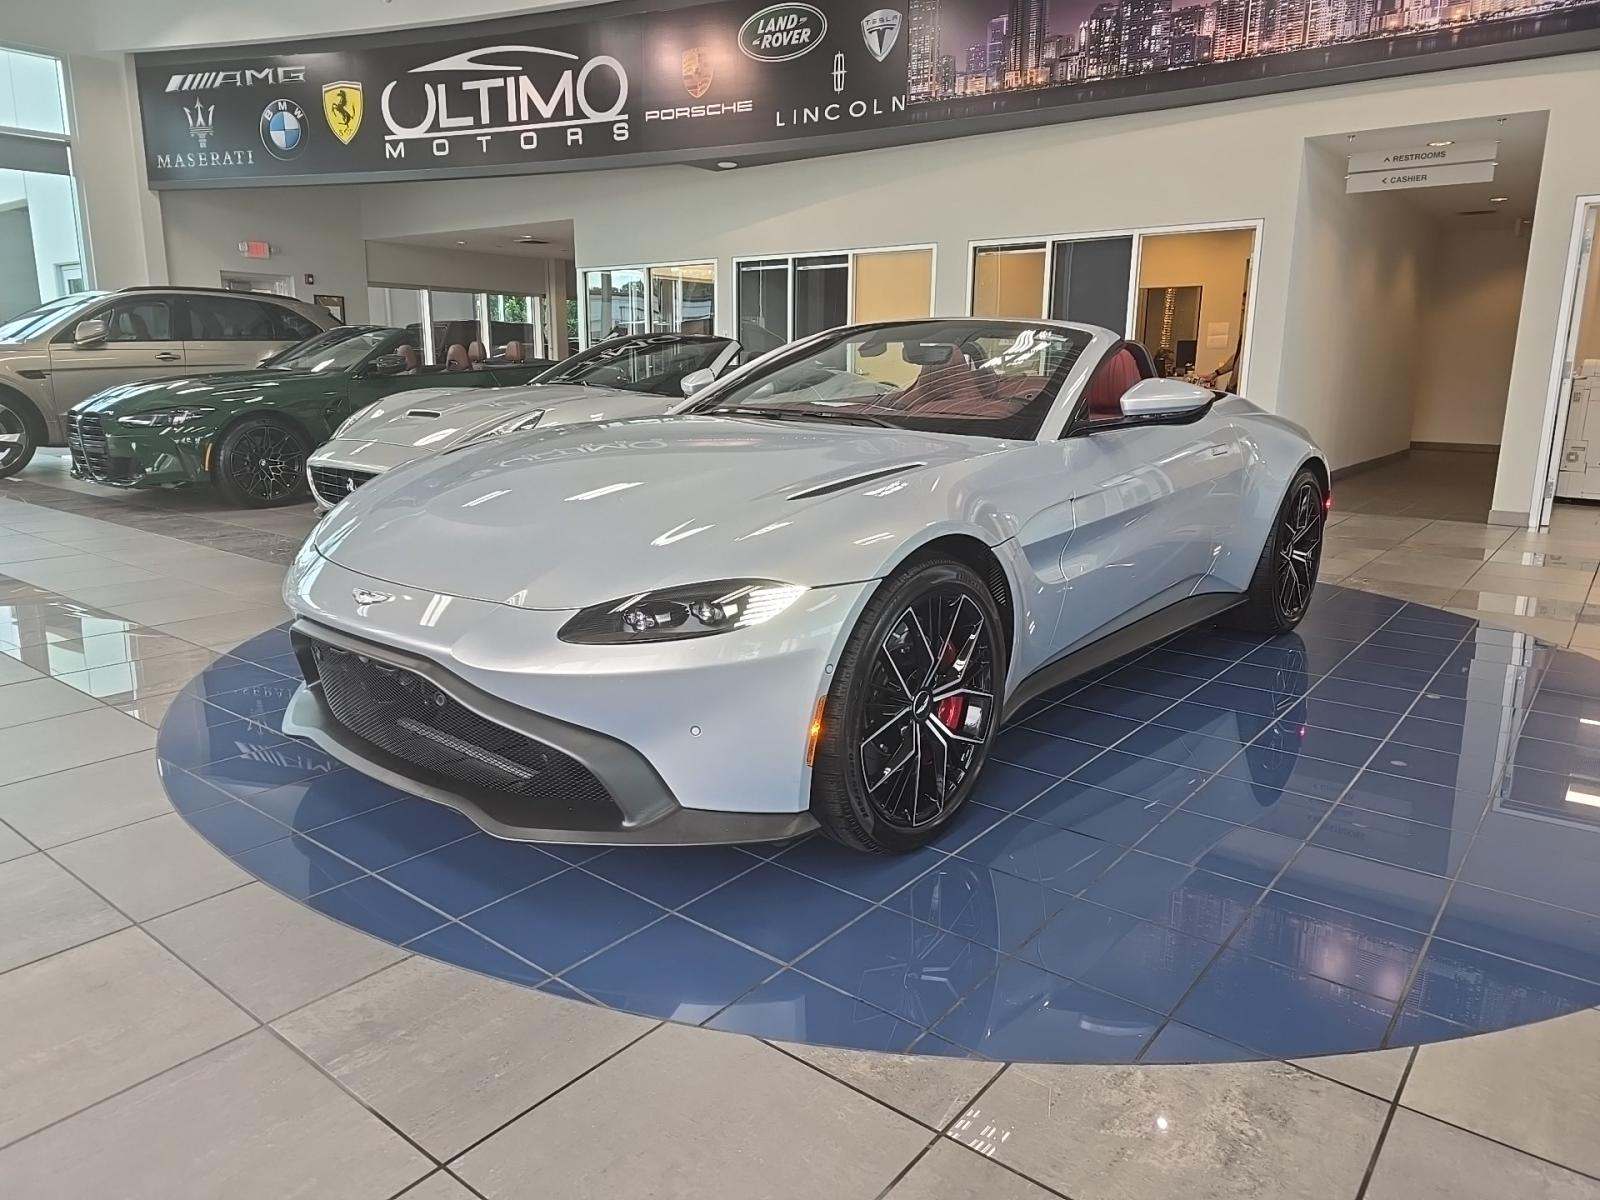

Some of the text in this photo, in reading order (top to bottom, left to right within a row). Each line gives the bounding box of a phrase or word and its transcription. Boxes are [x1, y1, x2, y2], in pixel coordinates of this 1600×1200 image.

[757, 14, 798, 34] LAND
[865, 15, 898, 25] TESLA
[760, 27, 810, 50] ROVER
[213, 66, 306, 89] AMG
[381, 55, 629, 136] ULTIMO
[263, 101, 304, 121] BMW
[645, 100, 753, 122] PORSCHE
[775, 95, 906, 127] LINCOLN
[384, 122, 630, 159] MOTORS
[157, 150, 255, 169] MASERATI
[1392, 150, 1447, 163] RESTROOMS
[1390, 174, 1428, 184] CASHIER
